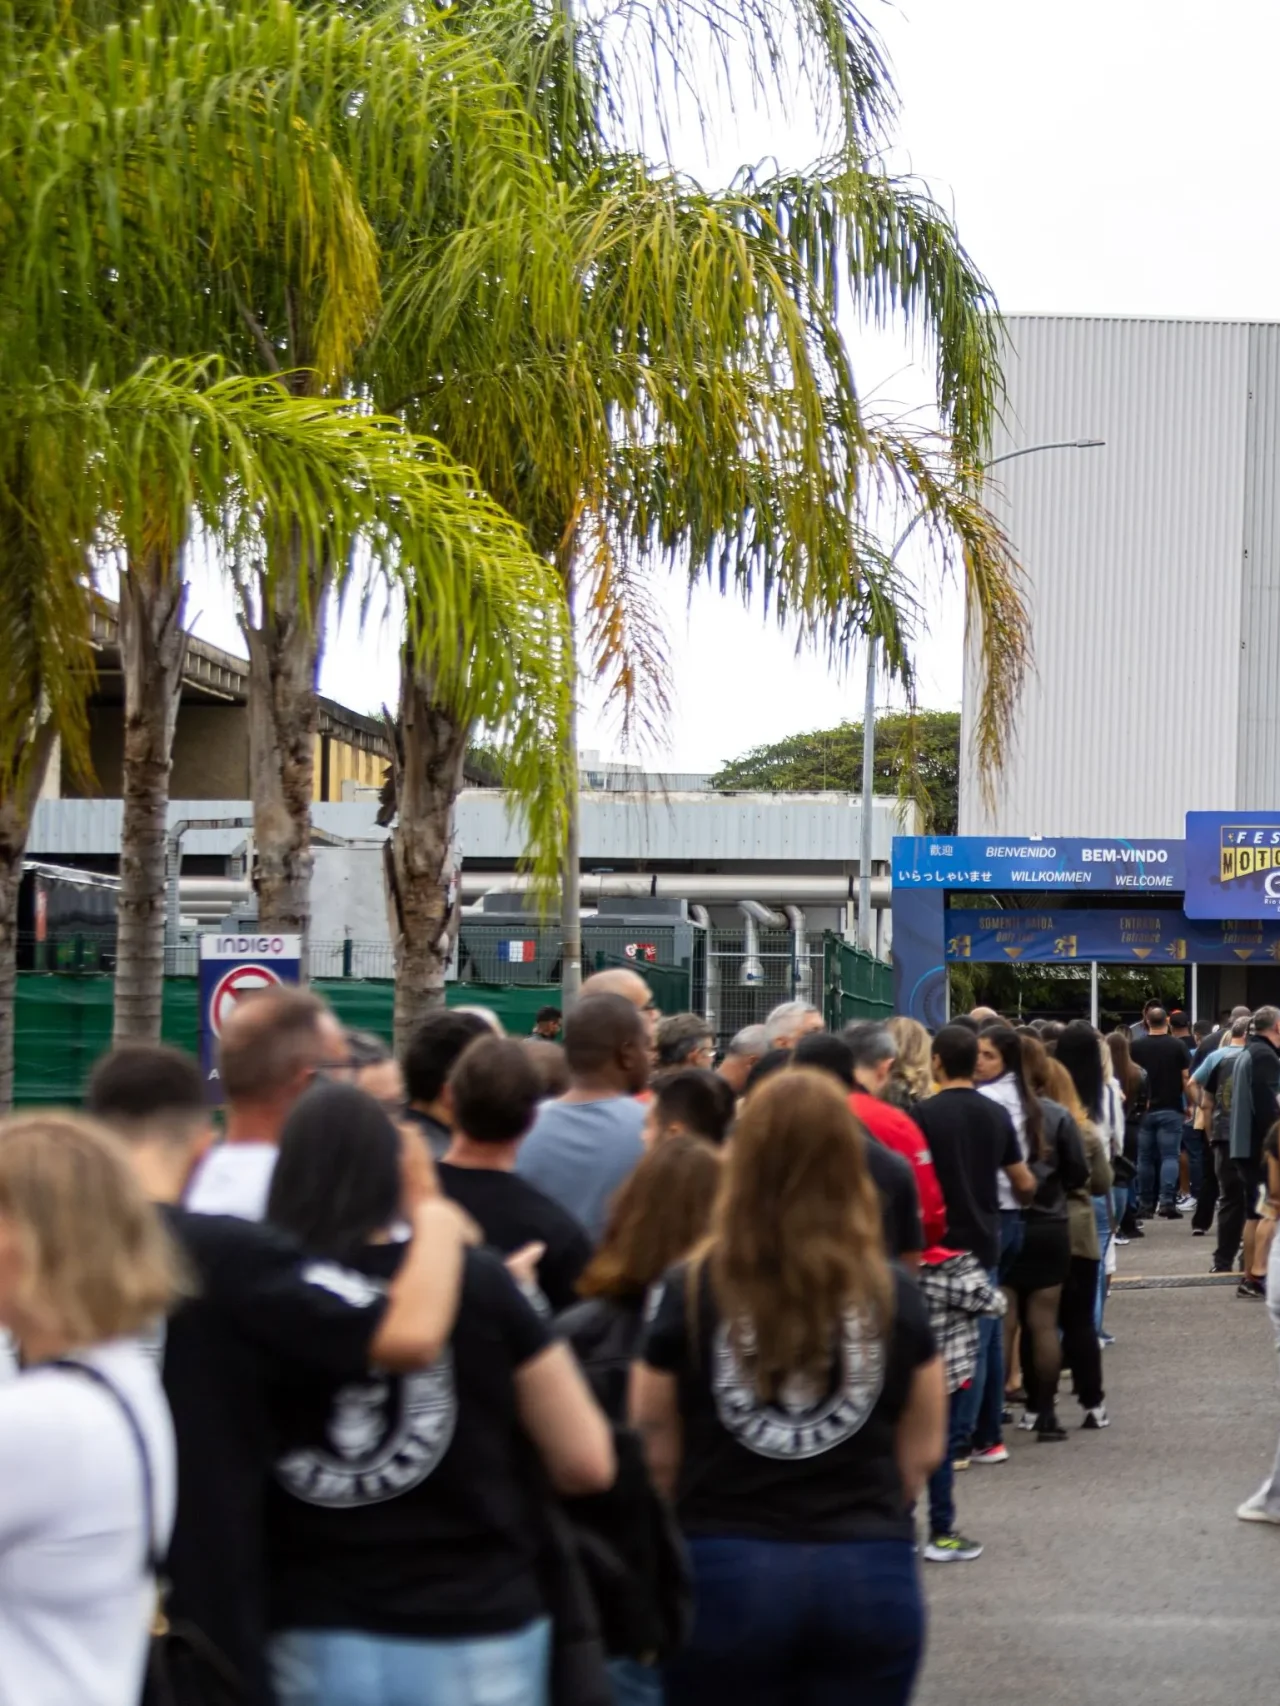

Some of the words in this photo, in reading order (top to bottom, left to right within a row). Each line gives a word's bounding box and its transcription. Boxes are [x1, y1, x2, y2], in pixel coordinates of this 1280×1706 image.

[986, 847, 1057, 859] BIENVENIDO
[1082, 849, 1168, 863] BEM-VINDO
[899, 870, 992, 883] いらっしゃいませ
[1011, 871, 1092, 883] WILLKOMMEN
[1115, 875, 1174, 887] WELCOME
